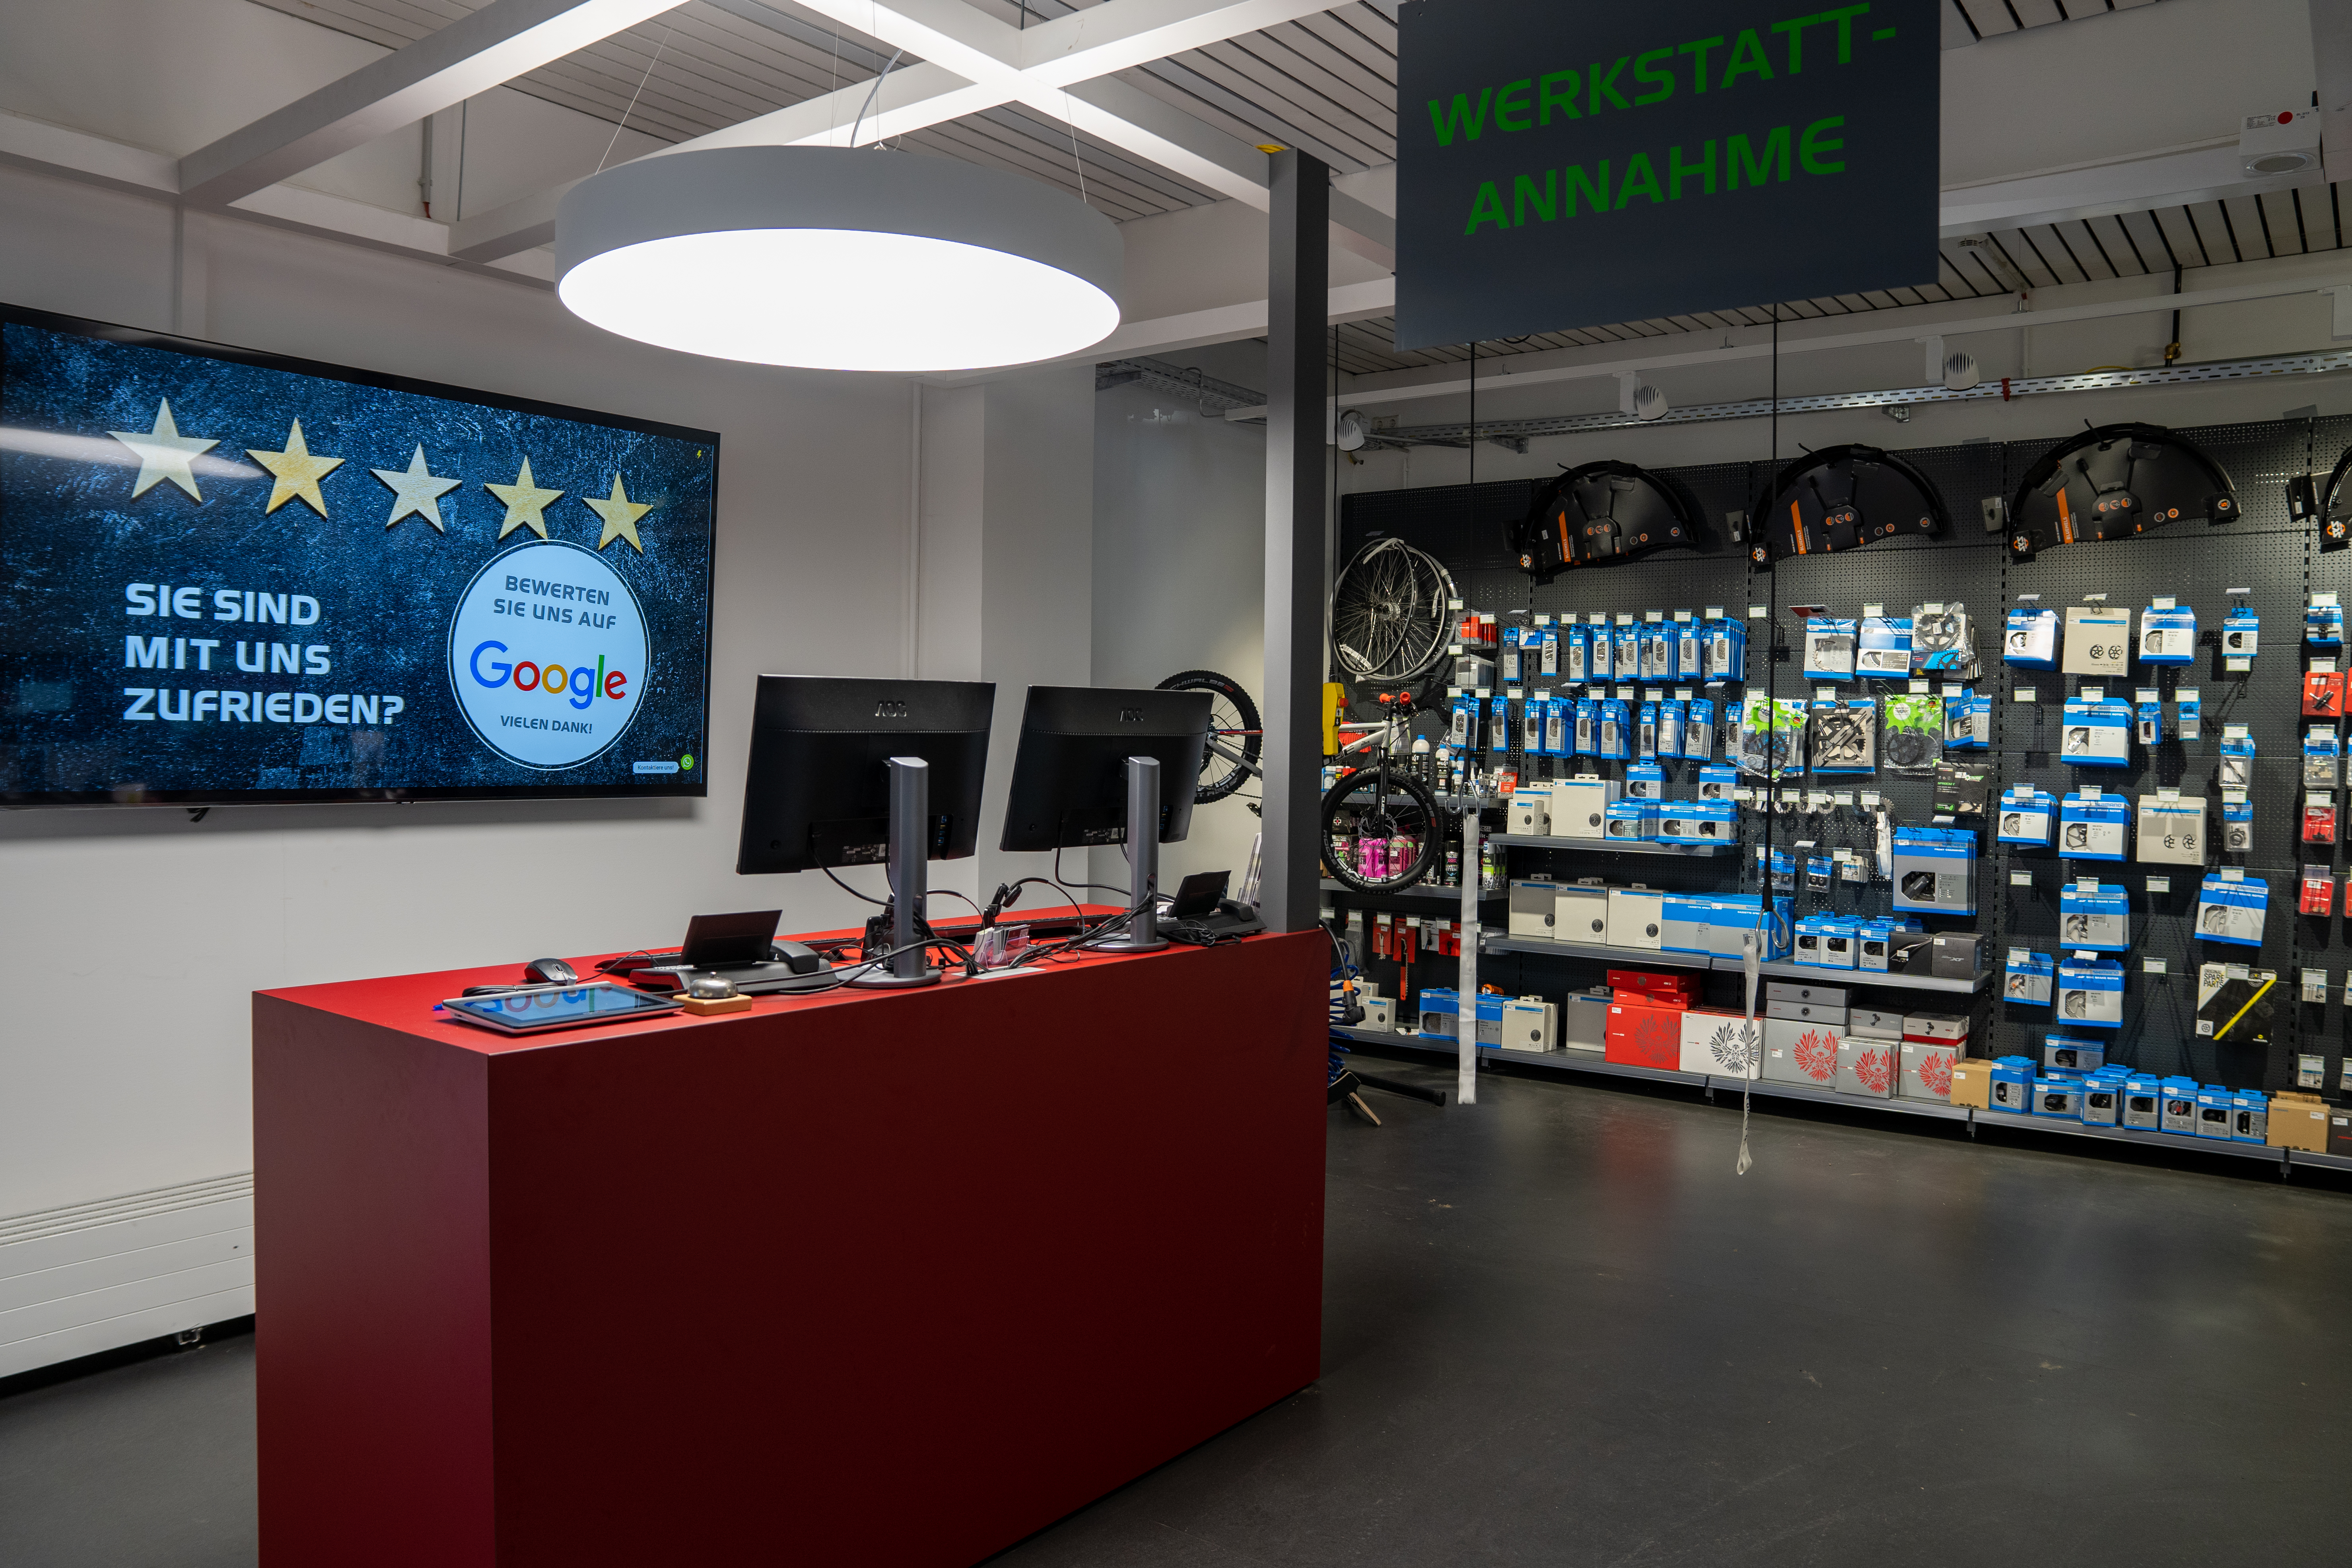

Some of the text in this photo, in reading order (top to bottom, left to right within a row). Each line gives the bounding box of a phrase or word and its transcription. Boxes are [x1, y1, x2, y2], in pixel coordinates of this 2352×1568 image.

[1428, 2, 1896, 147] WERKSTATT-
[1464, 115, 1845, 235] ANNAHME
[2063, 516, 2071, 540] BLUEMELS
[126, 583, 320, 626] SIE SIND
[505, 575, 610, 606] BEWERTEN
[494, 598, 617, 630] SIE UNS AUF
[125, 636, 331, 675] MIT UNS
[470, 640, 627, 711] Google
[1167, 678, 1225, 691] CHWALBE
[123, 688, 405, 724] ZUFRIEDEN?
[875, 700, 907, 717] AOC
[500, 714, 593, 734] VIELEN DANK!
[1323, 830, 1365, 886] ROCKET RON
[2203, 979, 2224, 988] PARTS
[2204, 973, 2224, 981] SPARE
